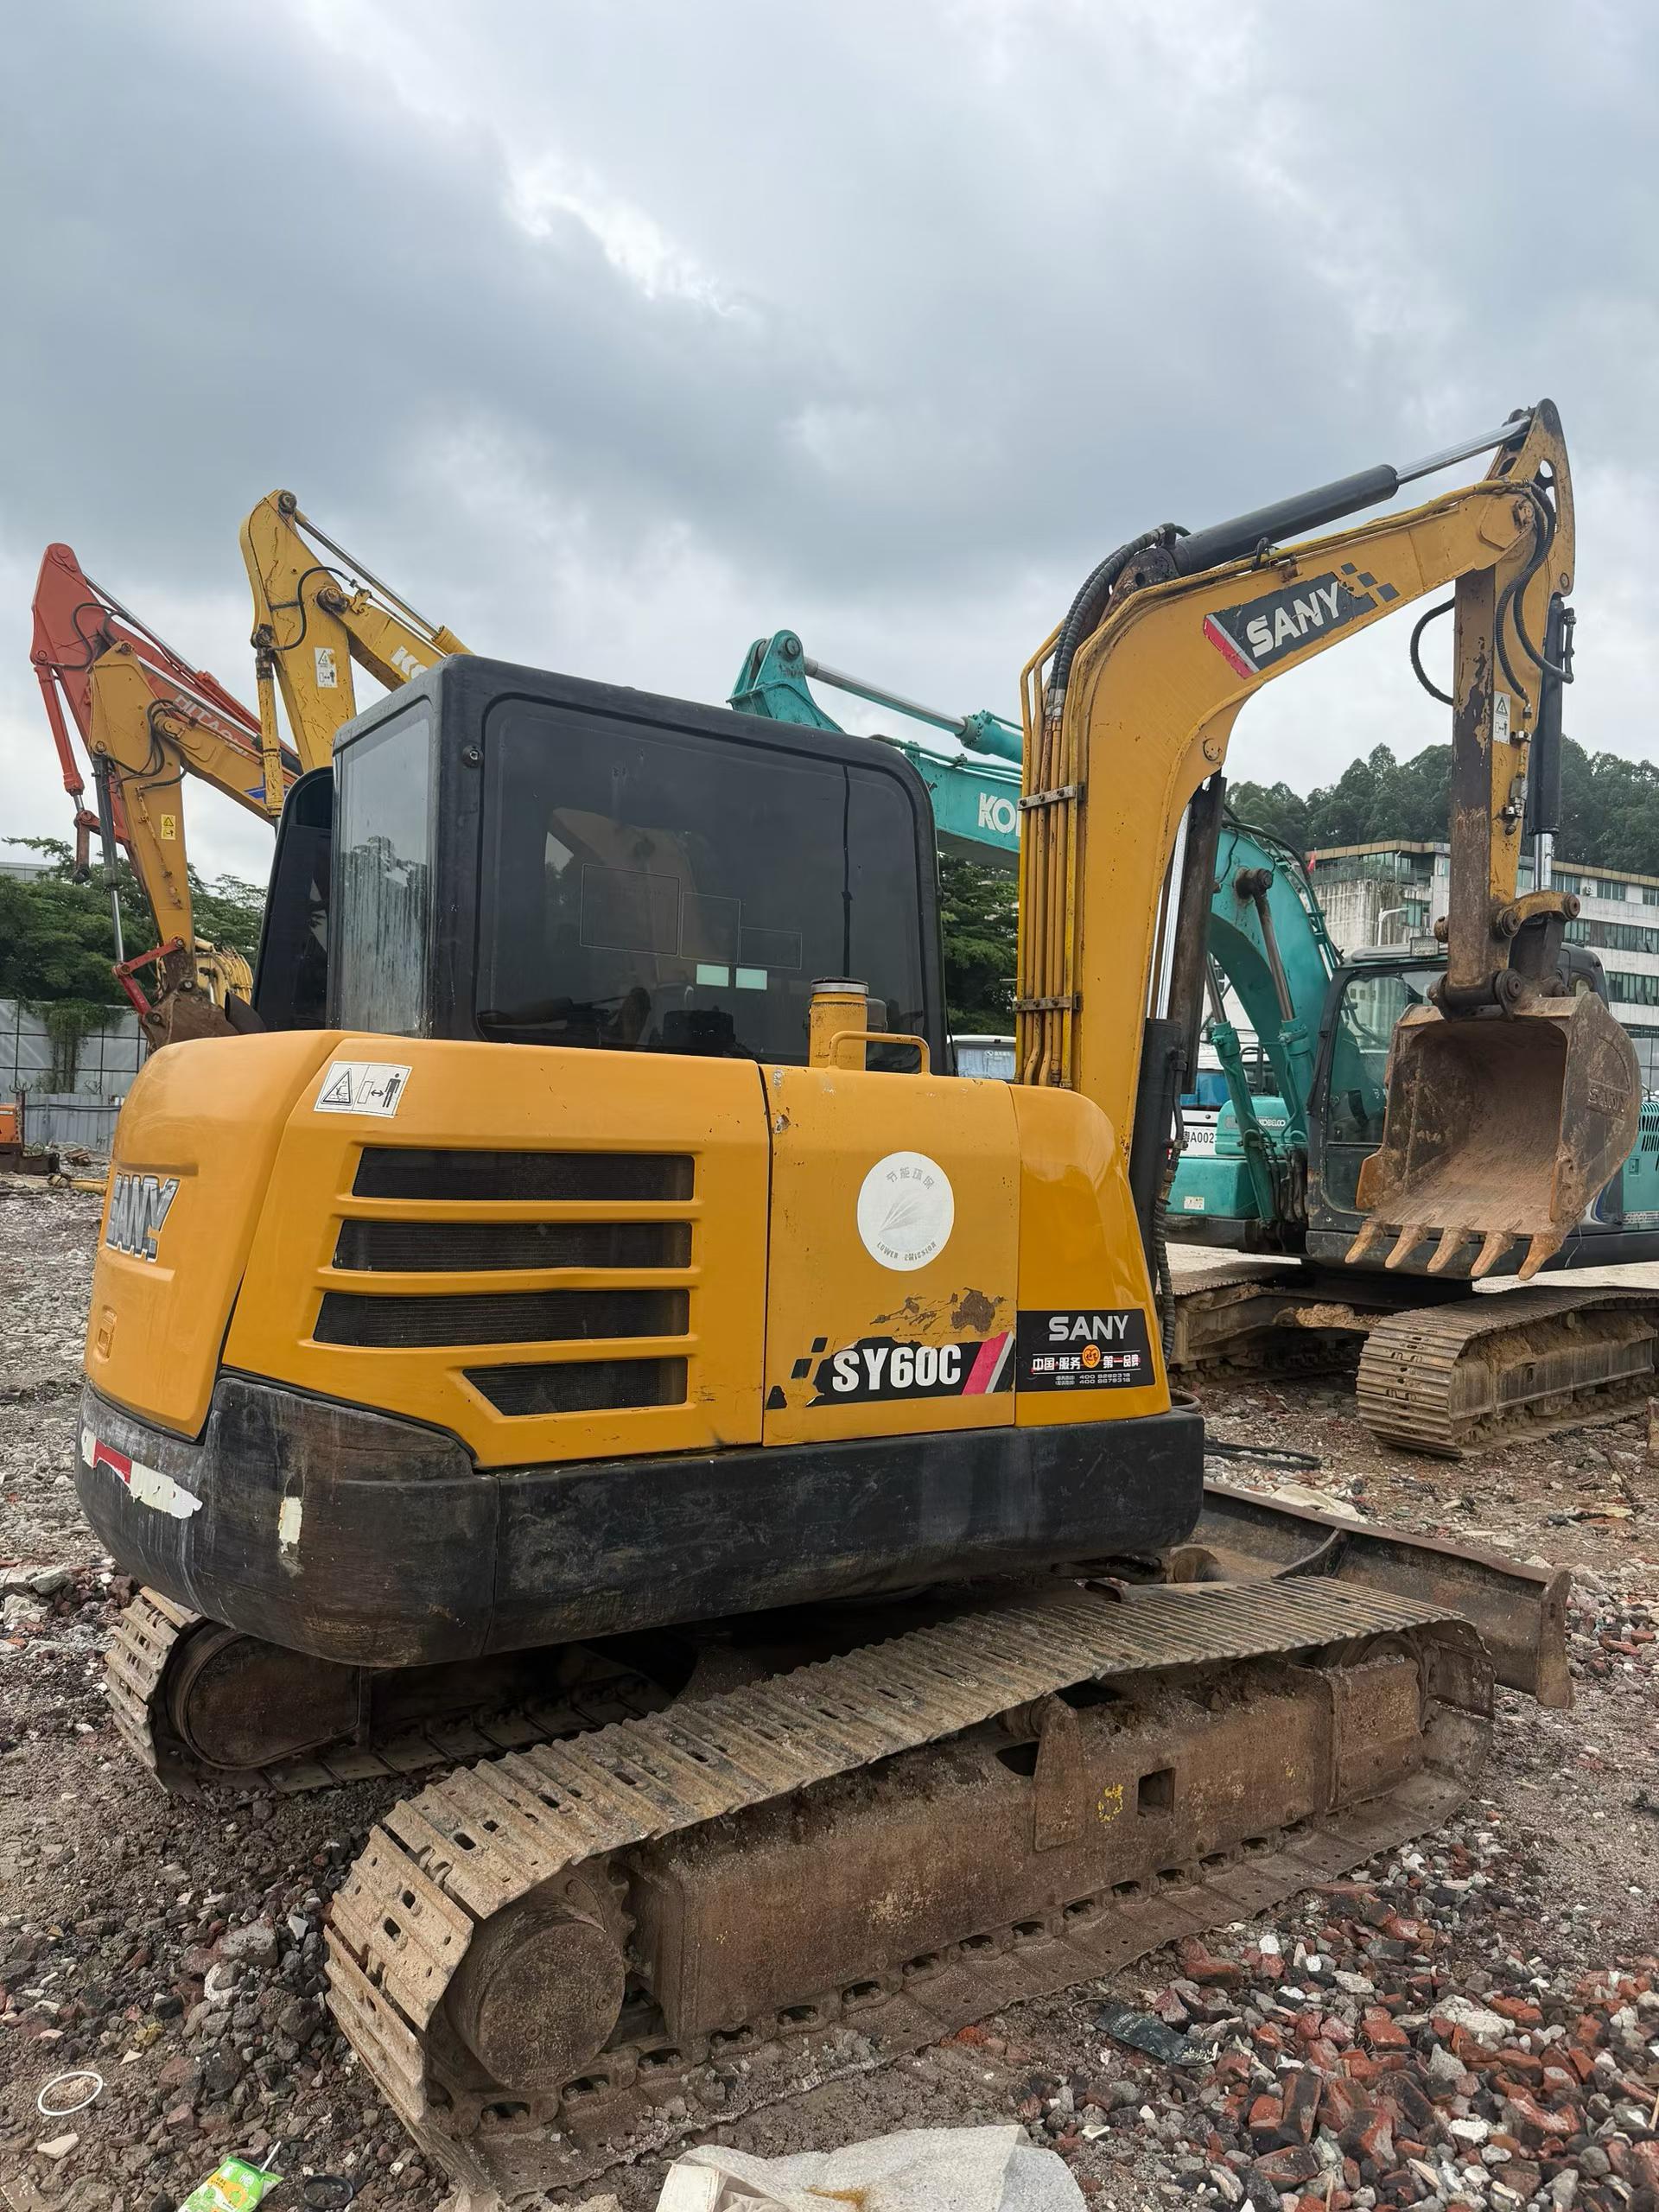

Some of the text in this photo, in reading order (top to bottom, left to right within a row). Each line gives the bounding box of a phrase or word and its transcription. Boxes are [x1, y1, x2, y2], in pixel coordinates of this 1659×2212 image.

[1246, 581, 1341, 658] SANY
[105, 1173, 181, 1263] SANY
[877, 1241, 938, 1262] LOWER EMISSION
[1048, 1314, 1129, 1342] SANY
[832, 1344, 962, 1393] SY60C
